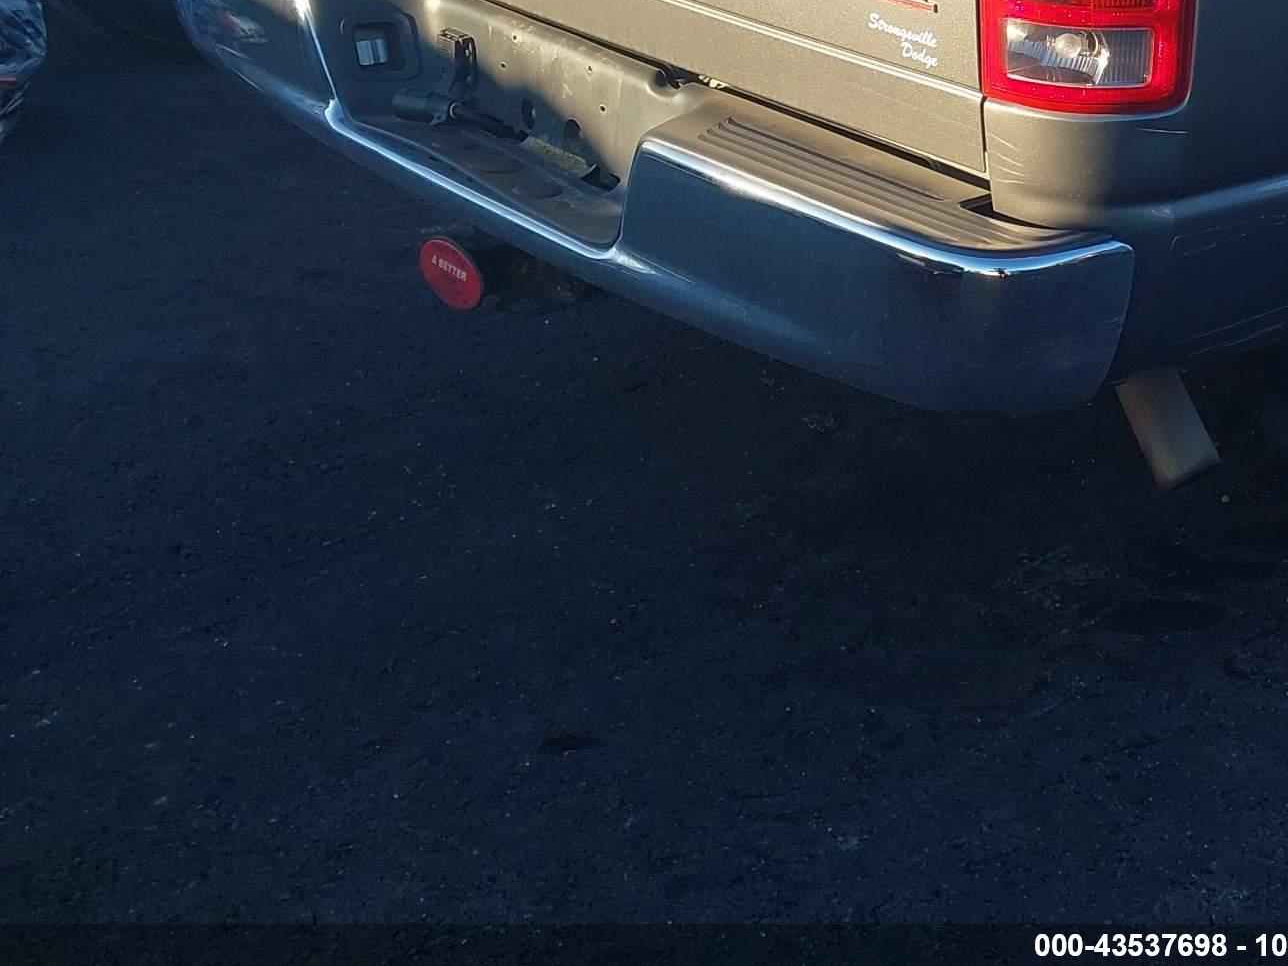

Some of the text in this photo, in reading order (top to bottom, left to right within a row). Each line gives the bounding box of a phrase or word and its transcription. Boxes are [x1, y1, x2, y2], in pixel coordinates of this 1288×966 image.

[902, 41, 938, 69] Dodge
[431, 255, 467, 282] A BETTER
